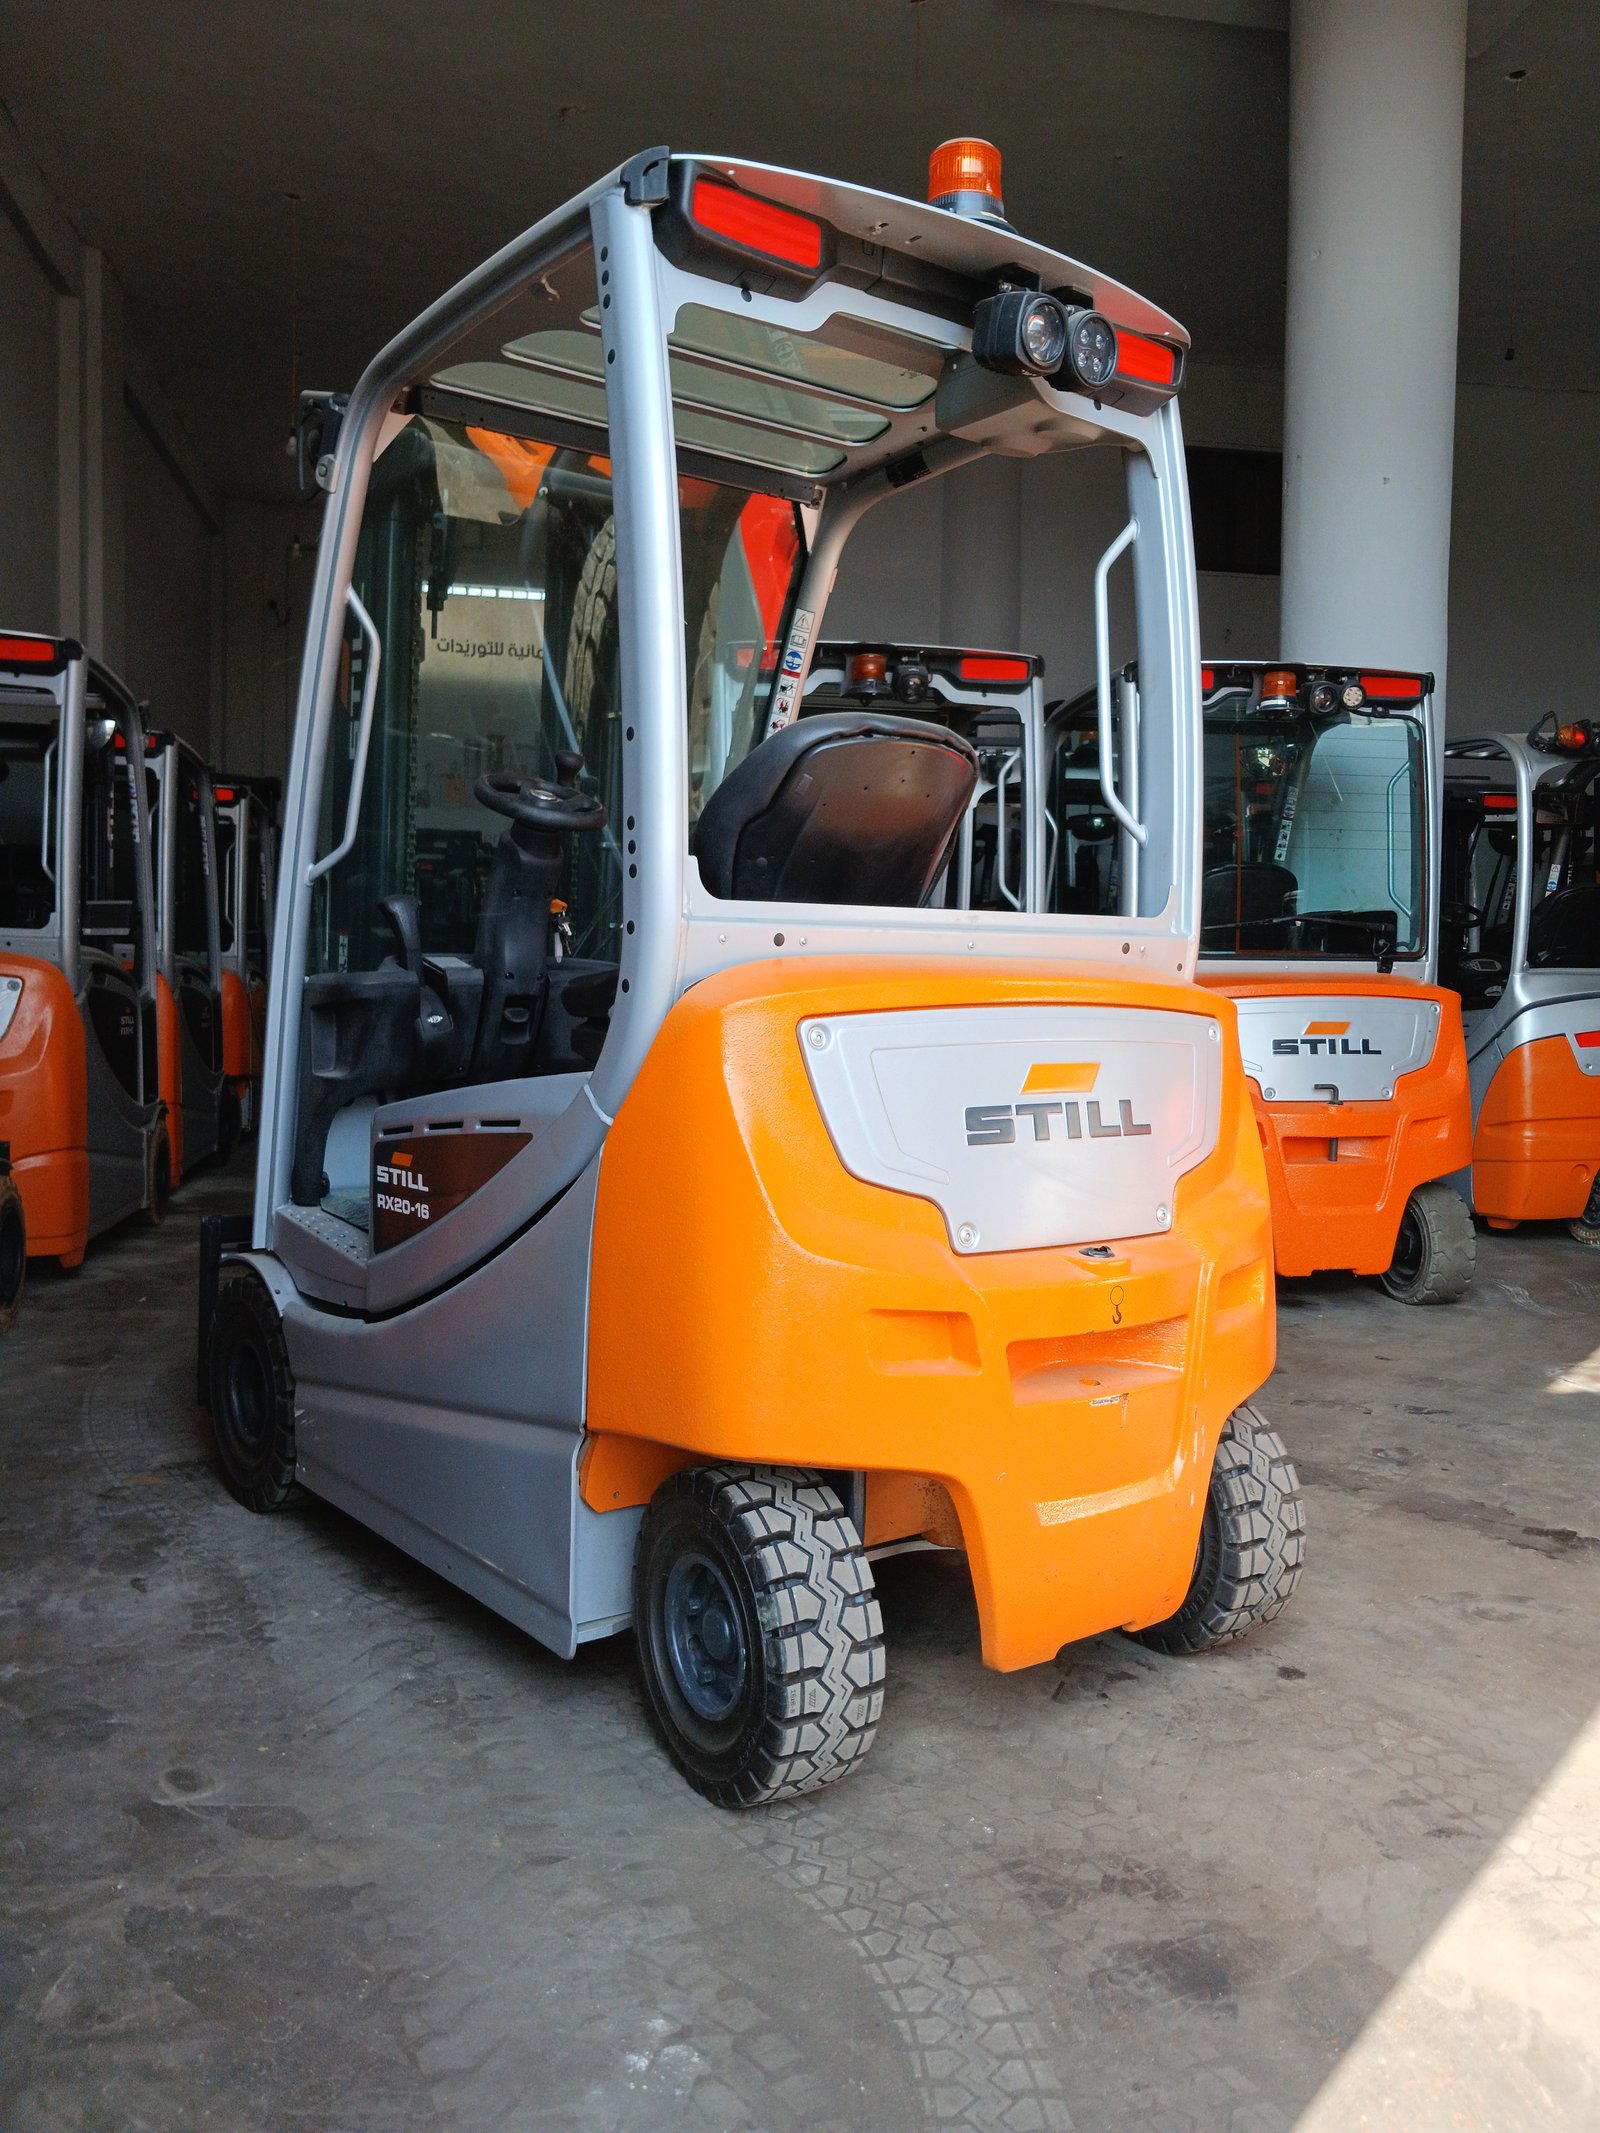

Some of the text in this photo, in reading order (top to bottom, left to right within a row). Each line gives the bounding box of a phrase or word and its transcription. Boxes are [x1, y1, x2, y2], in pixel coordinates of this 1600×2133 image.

[1272, 1038, 1382, 1055] STILL
[965, 1099, 1152, 1146] STILL
[376, 1165, 430, 1192] STILL
[376, 1193, 430, 1220] RX20-16
